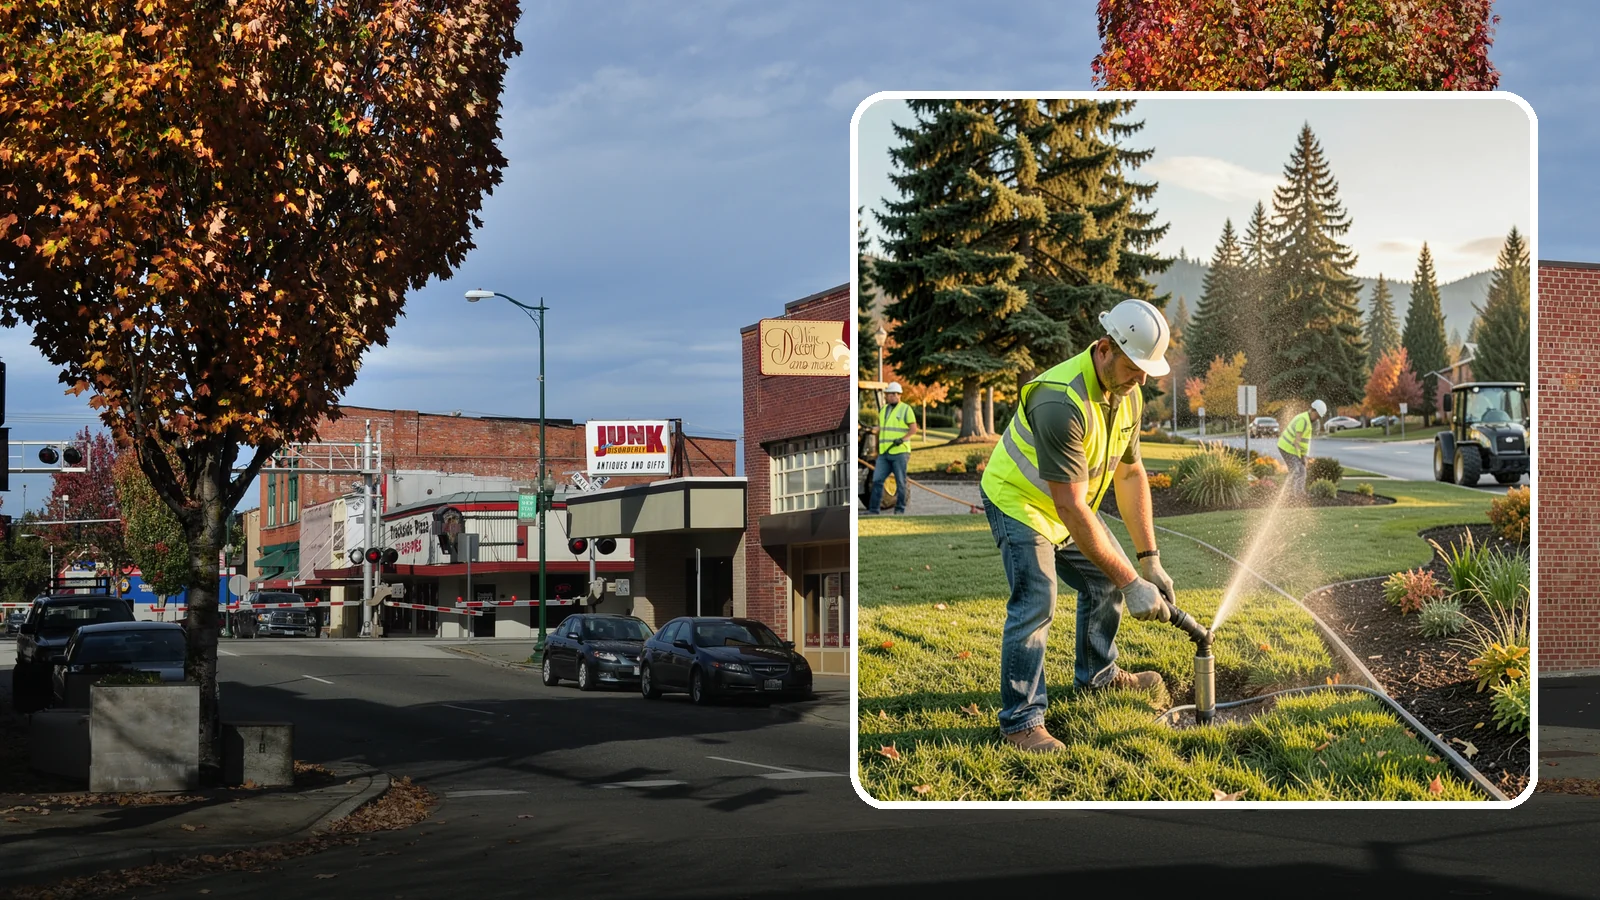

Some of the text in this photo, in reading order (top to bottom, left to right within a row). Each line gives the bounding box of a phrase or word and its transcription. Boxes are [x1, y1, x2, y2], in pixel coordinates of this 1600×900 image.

[596, 425, 665, 457] JUNK
[607, 446, 645, 454] DISORDERLY
[597, 460, 665, 470] ANTIQUES AND GIFTS
[573, 473, 589, 492] RAIL
[414, 519, 429, 535] Pizza
